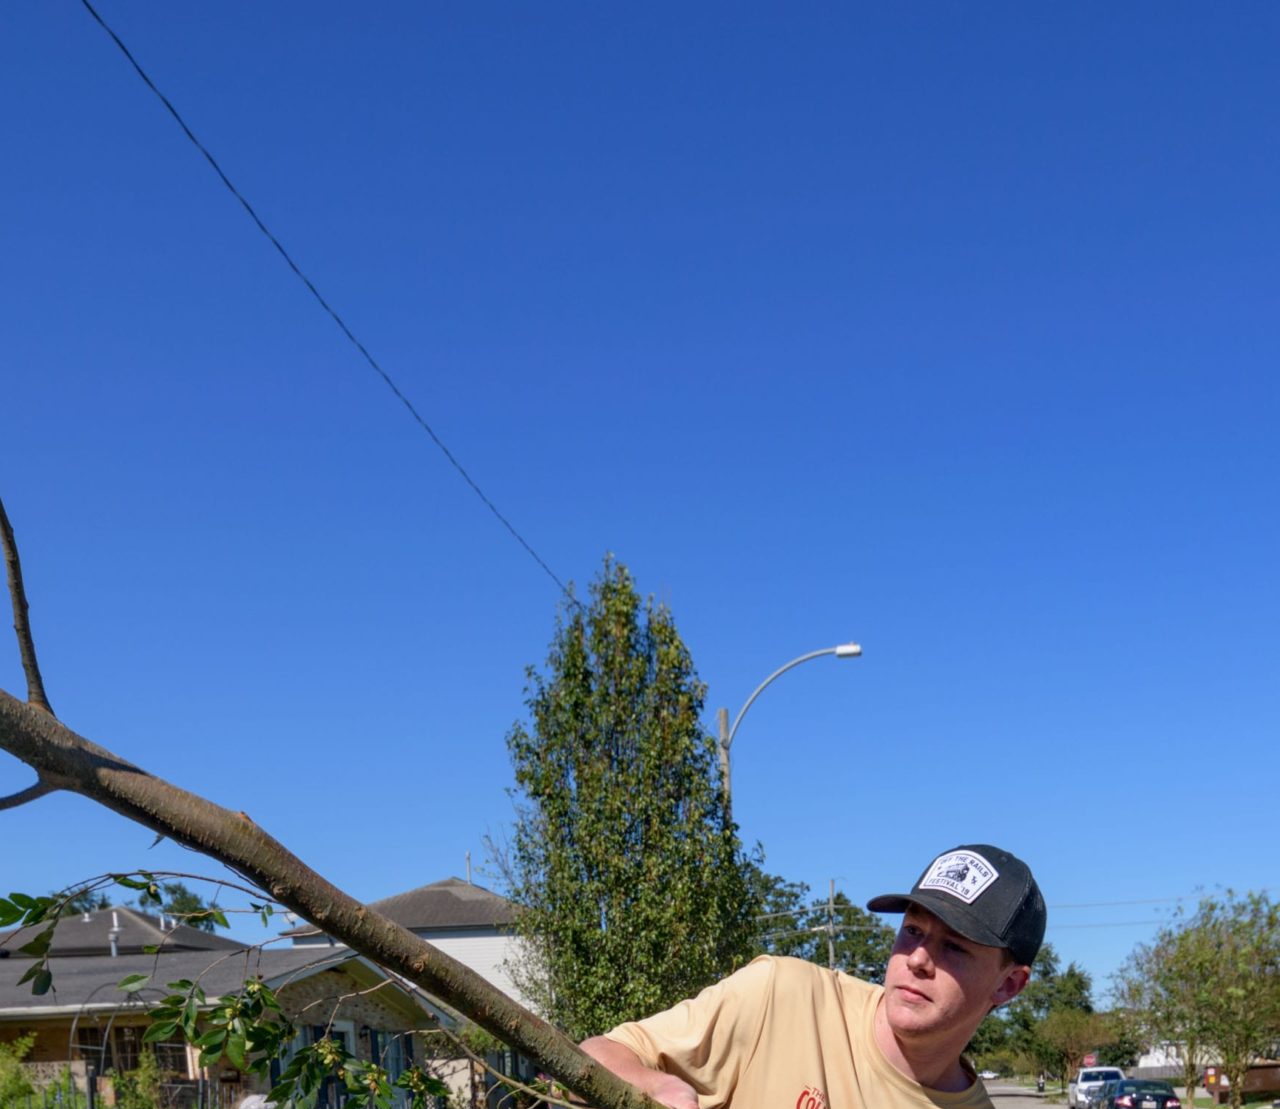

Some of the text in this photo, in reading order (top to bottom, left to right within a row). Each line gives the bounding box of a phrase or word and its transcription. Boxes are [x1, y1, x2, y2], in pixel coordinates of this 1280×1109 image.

[968, 860, 989, 878] RAILS
[928, 878, 959, 890] FESTIVAL
[812, 1087, 826, 1102] THE
